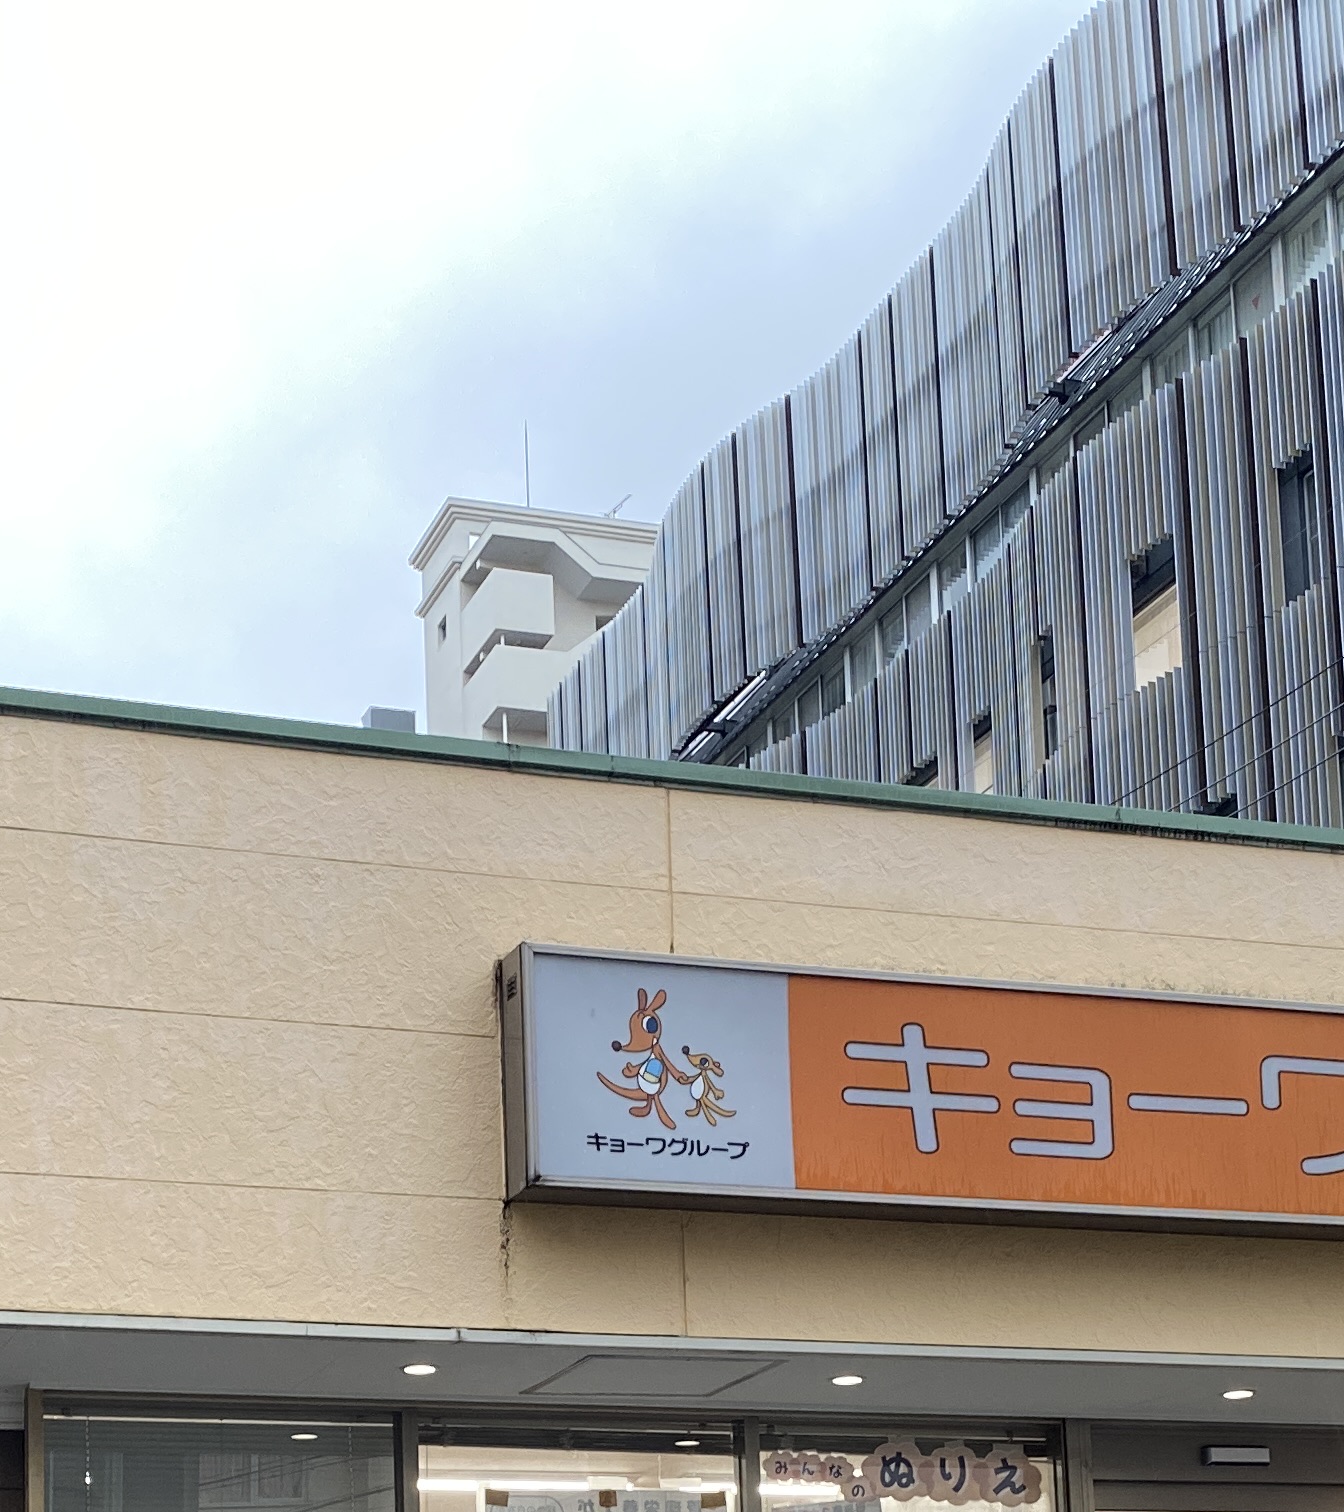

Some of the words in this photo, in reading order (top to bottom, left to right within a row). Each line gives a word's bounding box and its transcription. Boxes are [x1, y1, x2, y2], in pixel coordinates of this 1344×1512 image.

[585, 1130, 750, 1161] キョーワグループ
[774, 1460, 844, 1478] みんな
[879, 1451, 1027, 1496] ぬりえ
[851, 1484, 866, 1497] の
